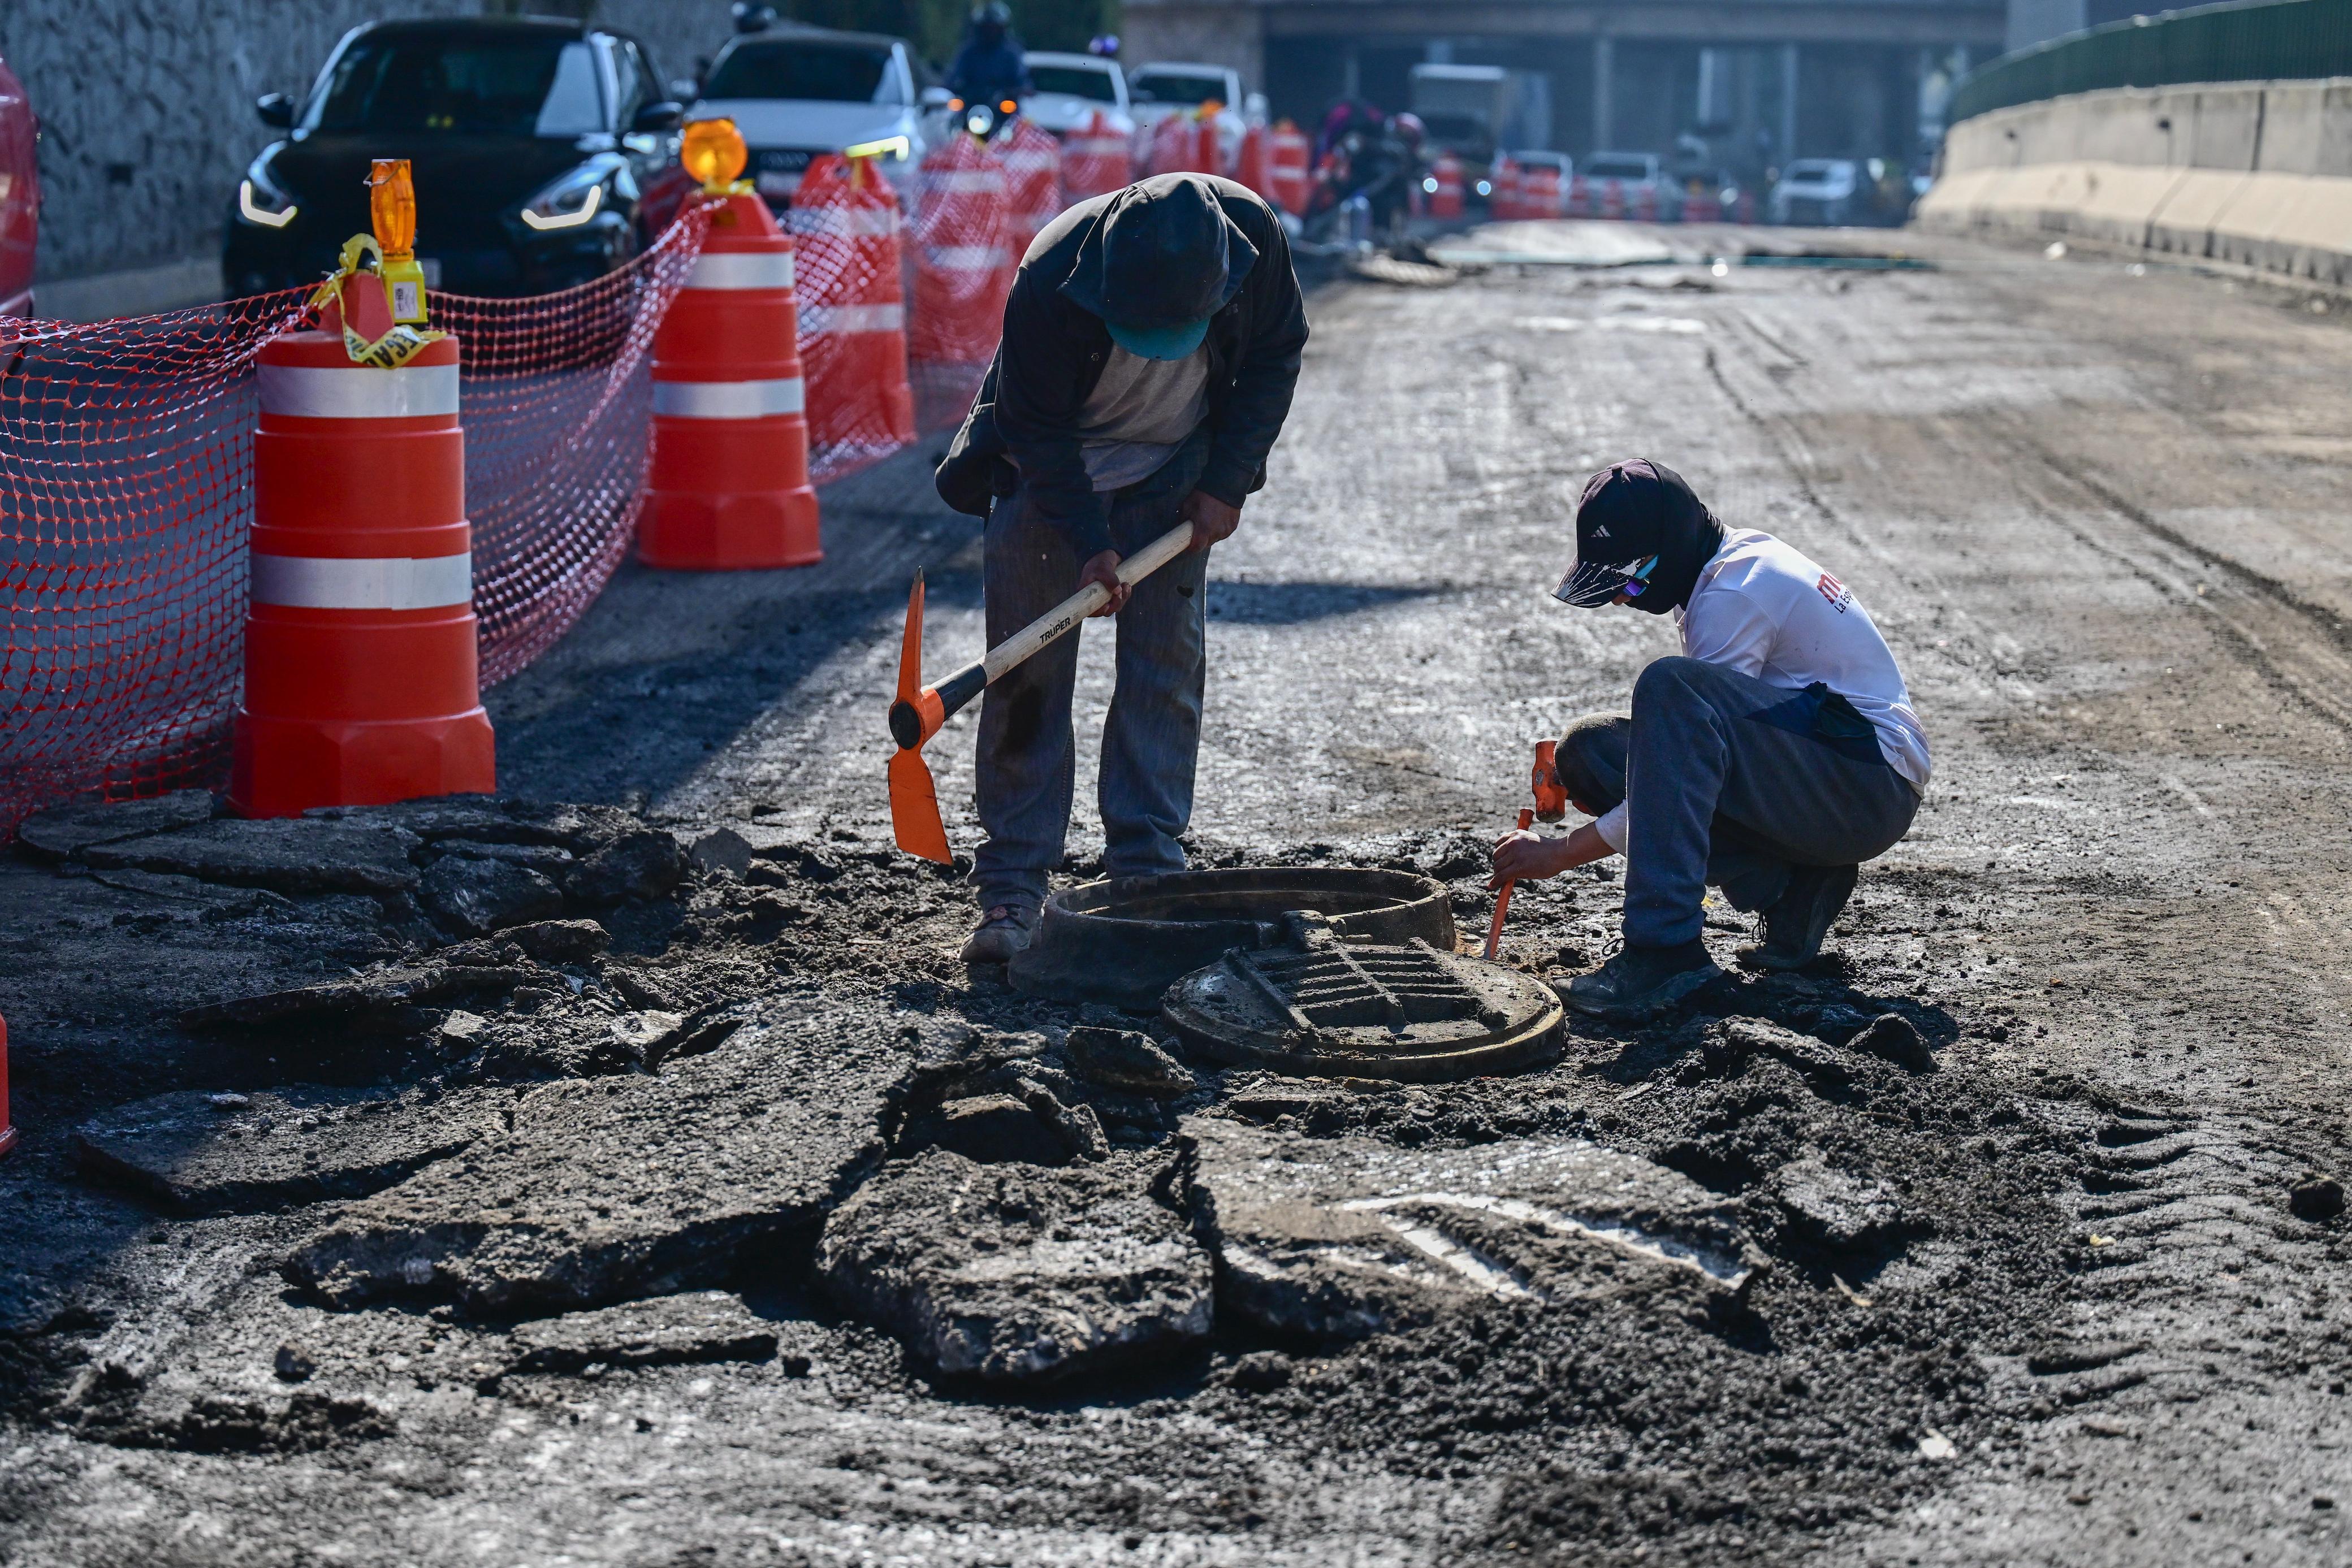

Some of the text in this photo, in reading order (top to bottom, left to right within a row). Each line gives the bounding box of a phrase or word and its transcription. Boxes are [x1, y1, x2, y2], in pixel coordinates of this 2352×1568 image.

[1834, 588, 1854, 614] La Esp
[1039, 617, 1071, 644] TRUPER
